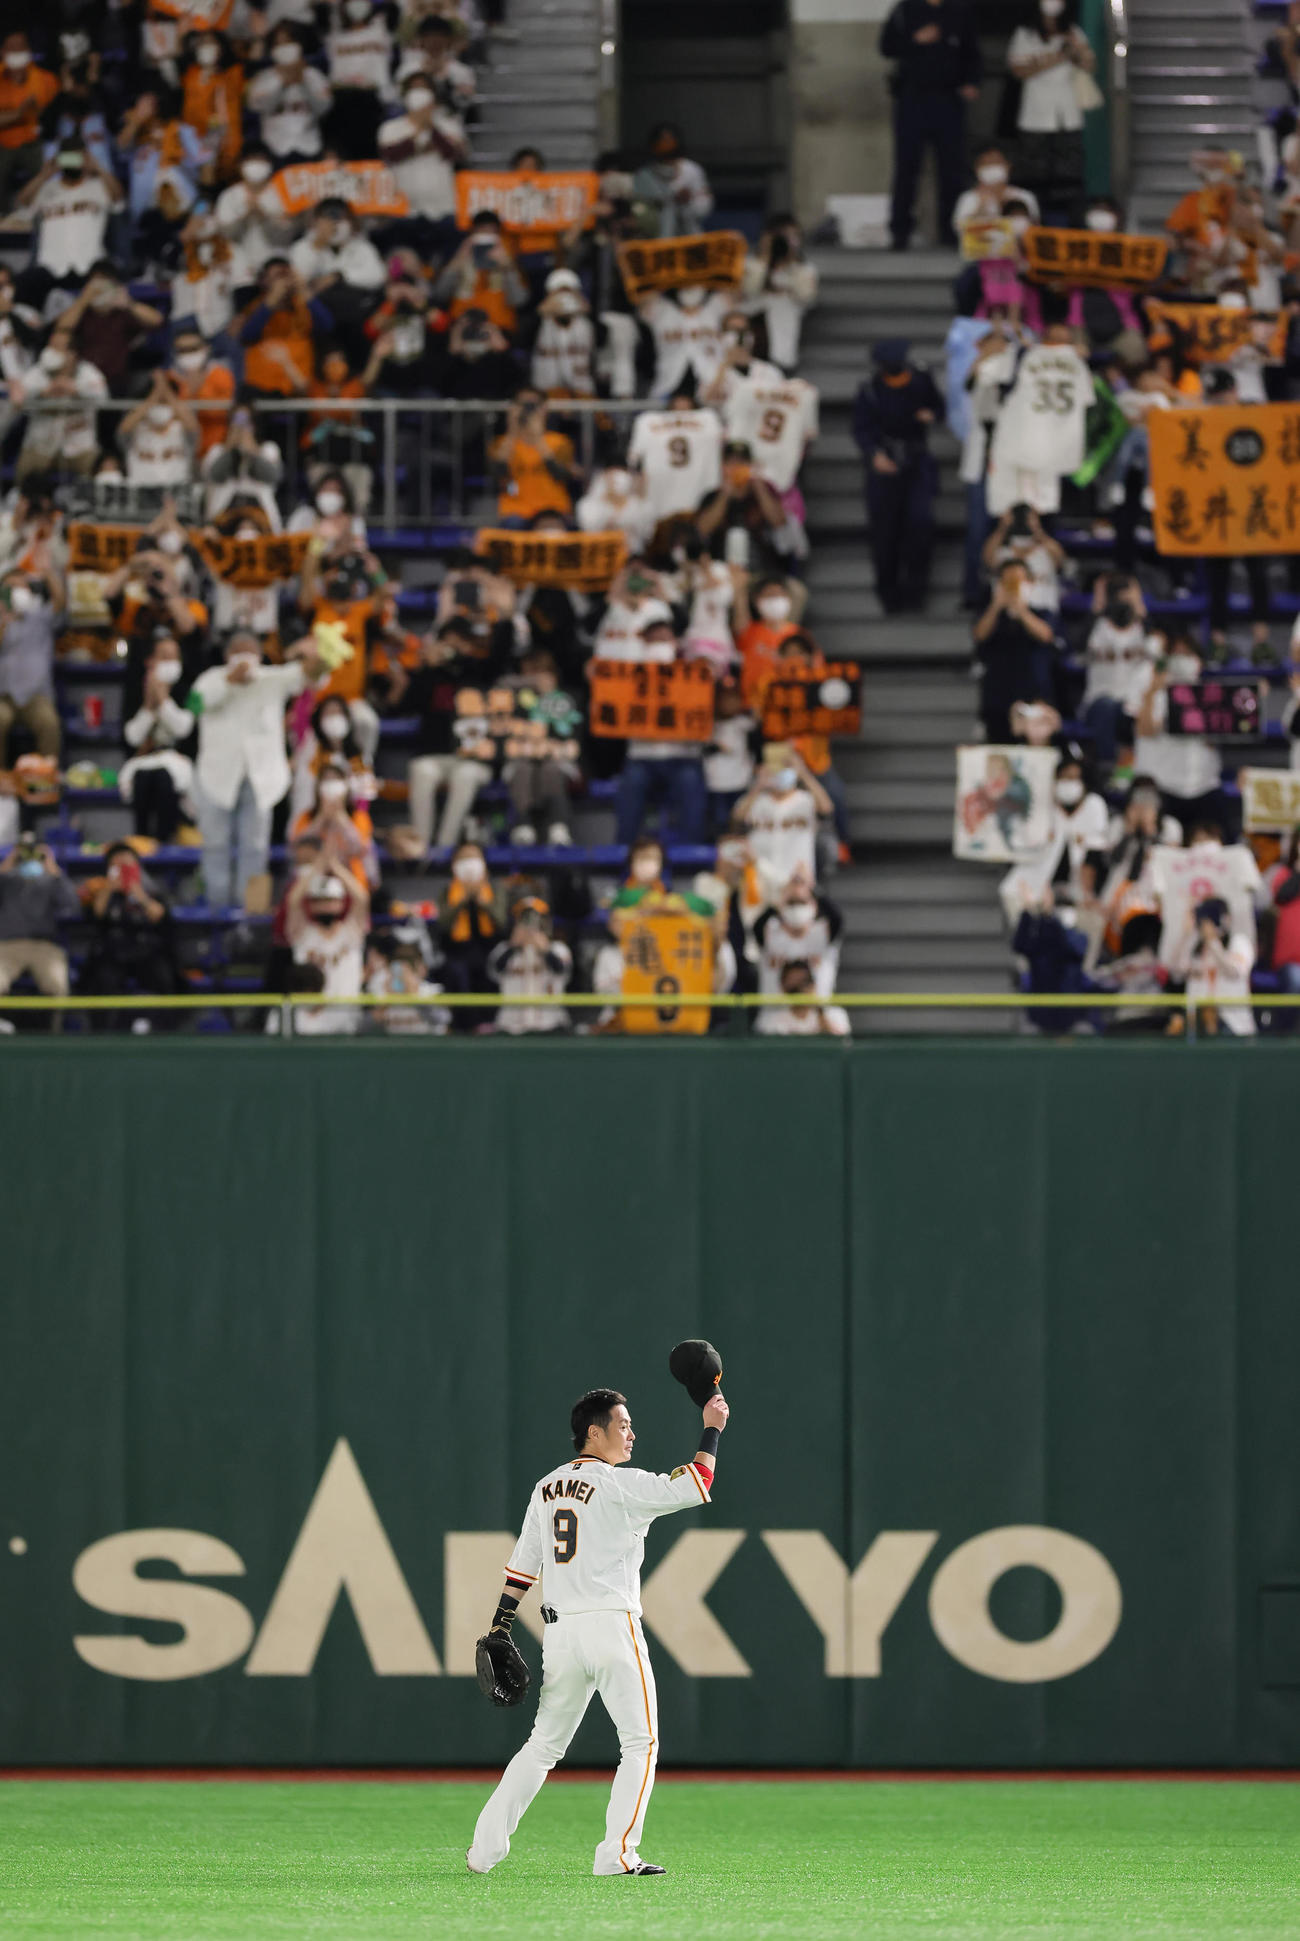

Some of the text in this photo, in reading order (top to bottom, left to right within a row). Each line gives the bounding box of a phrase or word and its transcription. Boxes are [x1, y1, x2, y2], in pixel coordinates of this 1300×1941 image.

[1032, 380, 1075, 415] 35
[759, 408, 787, 442] 9
[668, 435, 691, 468] 9
[541, 1479, 597, 1505] KAMEI
[553, 1508, 579, 1564] 9
